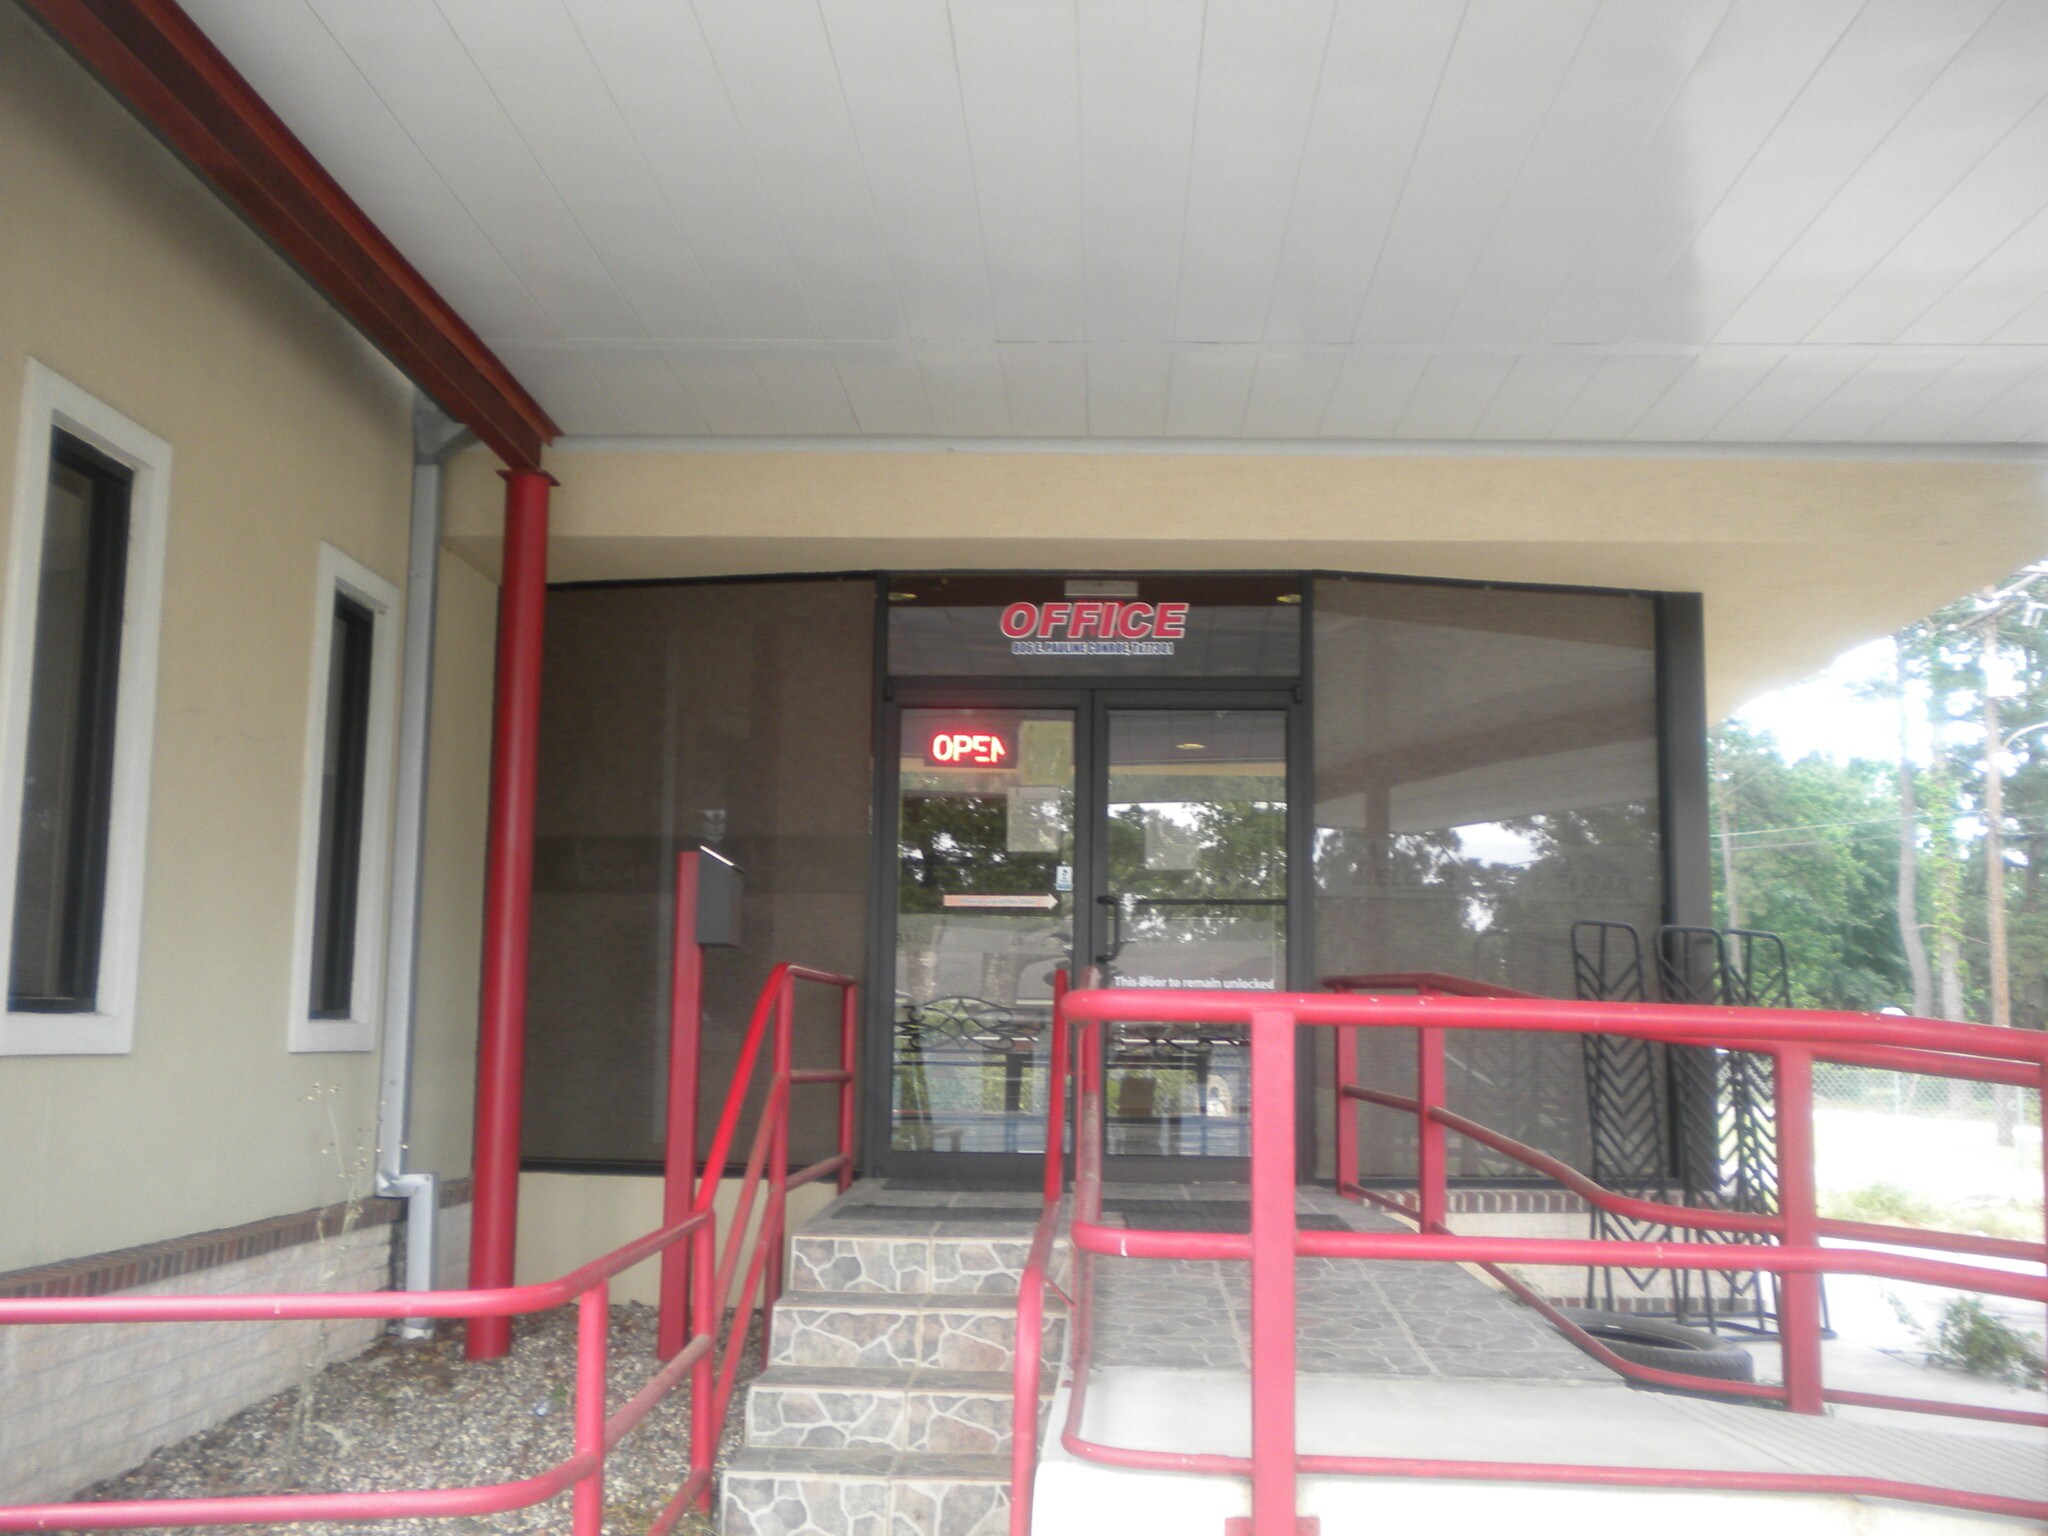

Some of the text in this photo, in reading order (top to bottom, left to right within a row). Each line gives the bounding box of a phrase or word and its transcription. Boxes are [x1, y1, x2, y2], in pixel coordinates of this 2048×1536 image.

[1000, 601, 1189, 639] OFFICE
[932, 734, 1006, 763] OPEN
[1114, 976, 1137, 987] This
[1168, 978, 1181, 988] to
[1182, 977, 1222, 989] remain
[1223, 977, 1275, 990] unlocked
